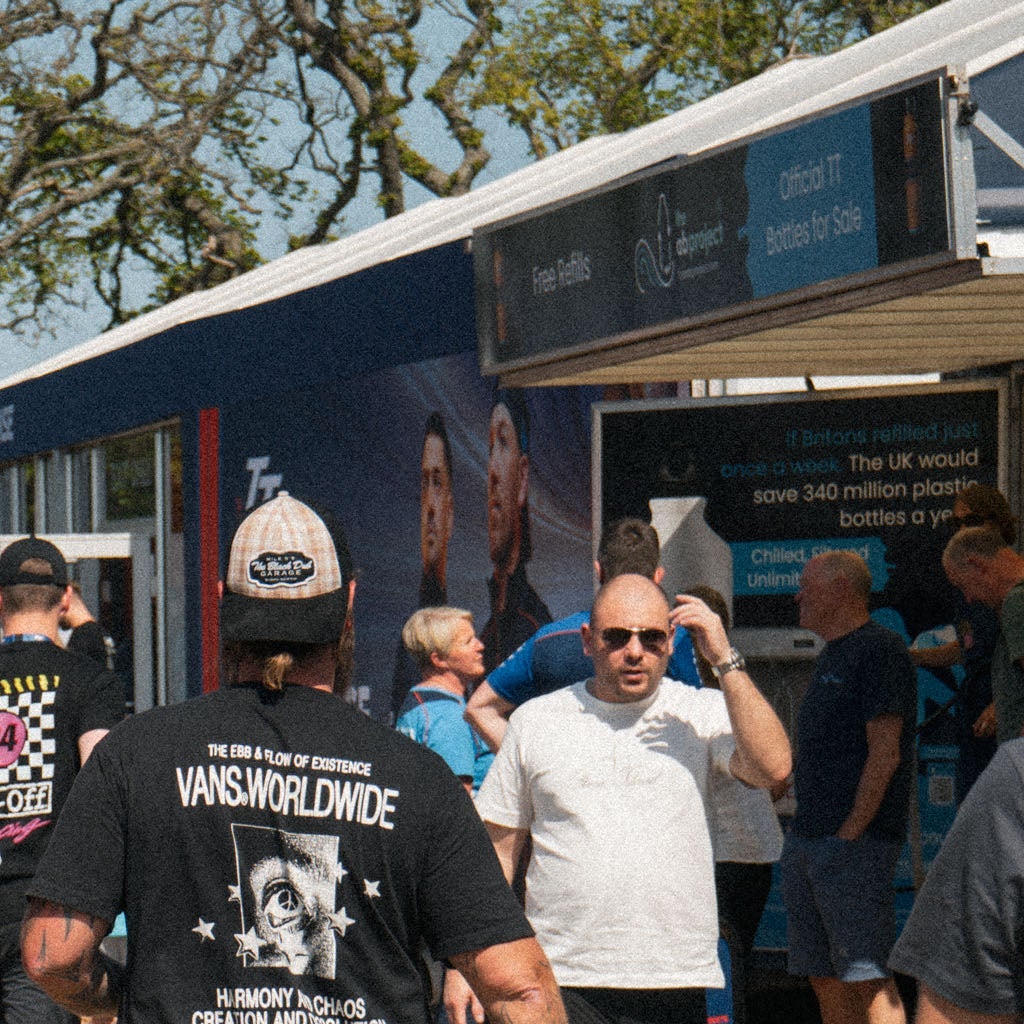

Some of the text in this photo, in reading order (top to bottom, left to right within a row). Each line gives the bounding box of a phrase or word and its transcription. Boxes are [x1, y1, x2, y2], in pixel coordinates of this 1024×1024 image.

[779, 153, 841, 200] Official TT
[766, 200, 862, 256] Bottles for Sale
[532, 251, 592, 295] Free Refills
[942, 420, 978, 443] just
[848, 454, 883, 472] The
[888, 452, 913, 470] UK
[917, 448, 978, 469] would
[753, 487, 798, 504] save
[803, 483, 838, 501] 340
[843, 480, 907, 500] million
[839, 508, 953, 529] bottles a ye
[208, 744, 372, 777] THE EBB & FLOW OF EXISTENCE
[216, 987, 294, 1009] HARMONY
[313, 994, 366, 1020] CHAOS
